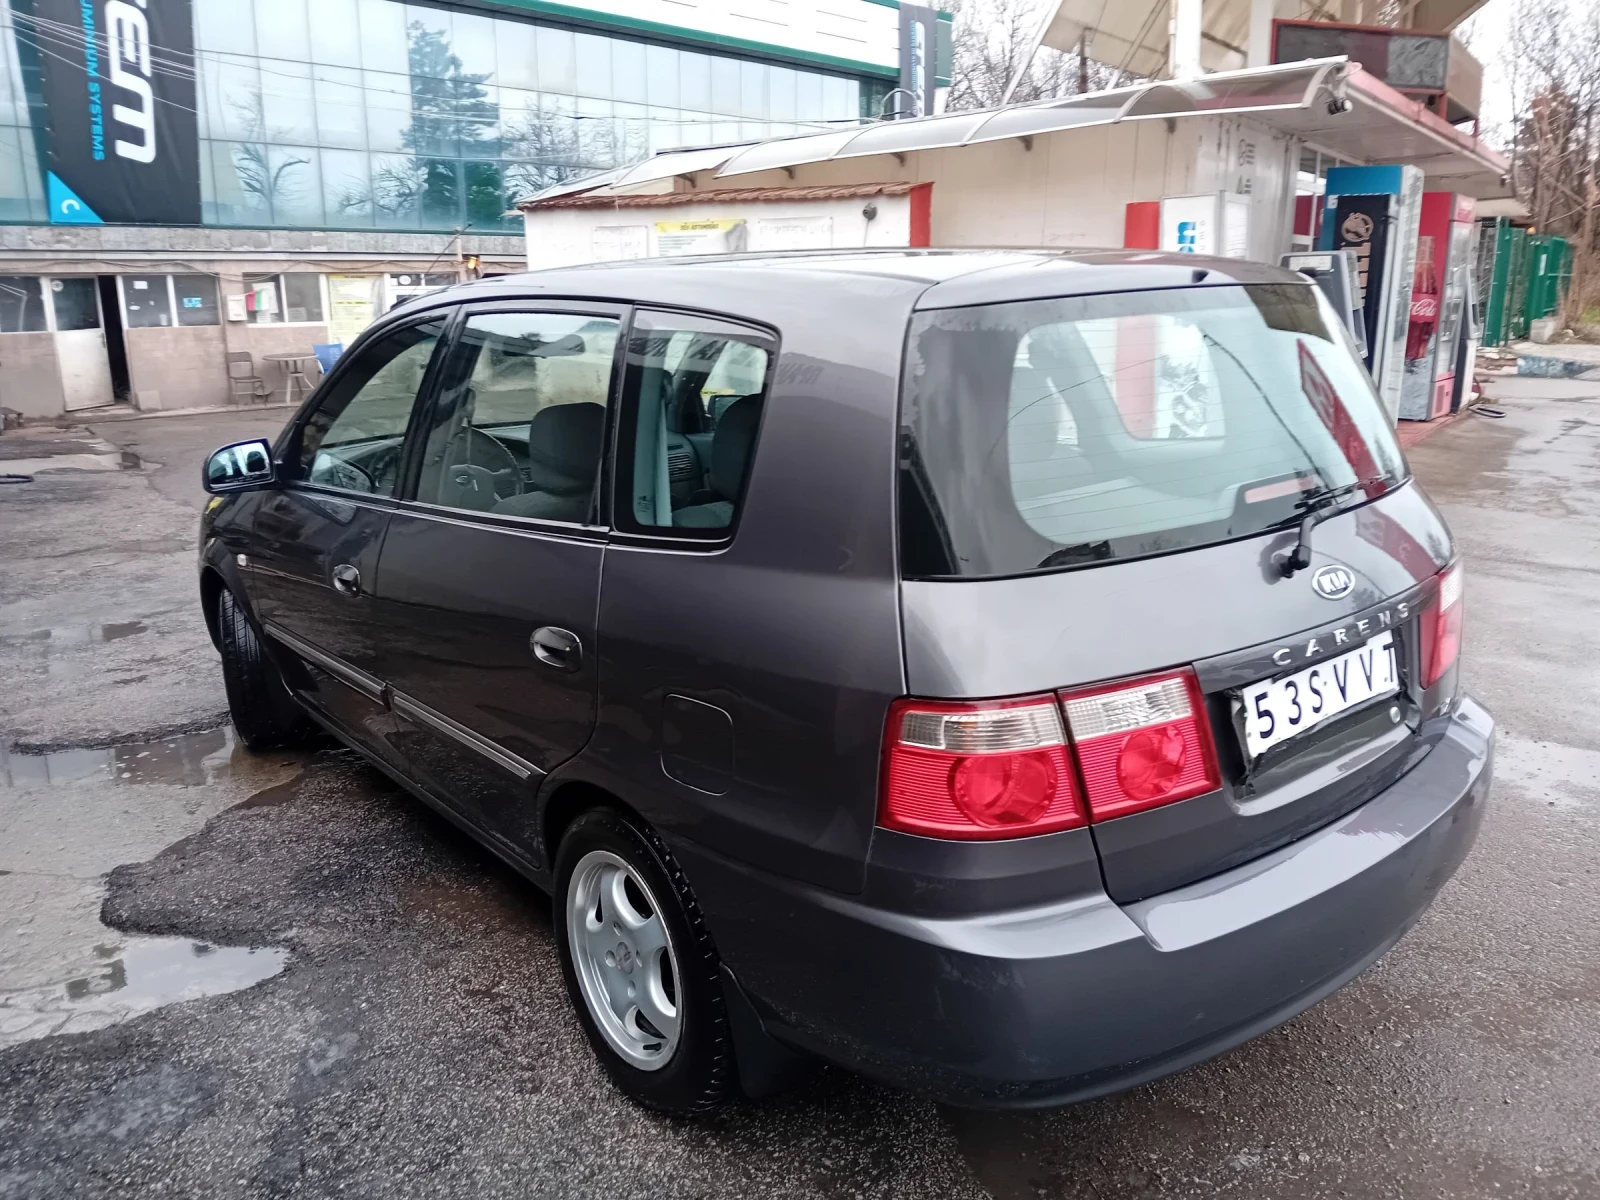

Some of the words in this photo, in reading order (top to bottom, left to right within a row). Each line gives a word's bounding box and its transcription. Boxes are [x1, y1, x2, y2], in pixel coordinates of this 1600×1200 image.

[104, 0, 156, 163] em
[87, 81, 105, 161] SYSTEMS
[1318, 570, 1351, 594] KIA
[1272, 602, 1410, 666] CARENS
